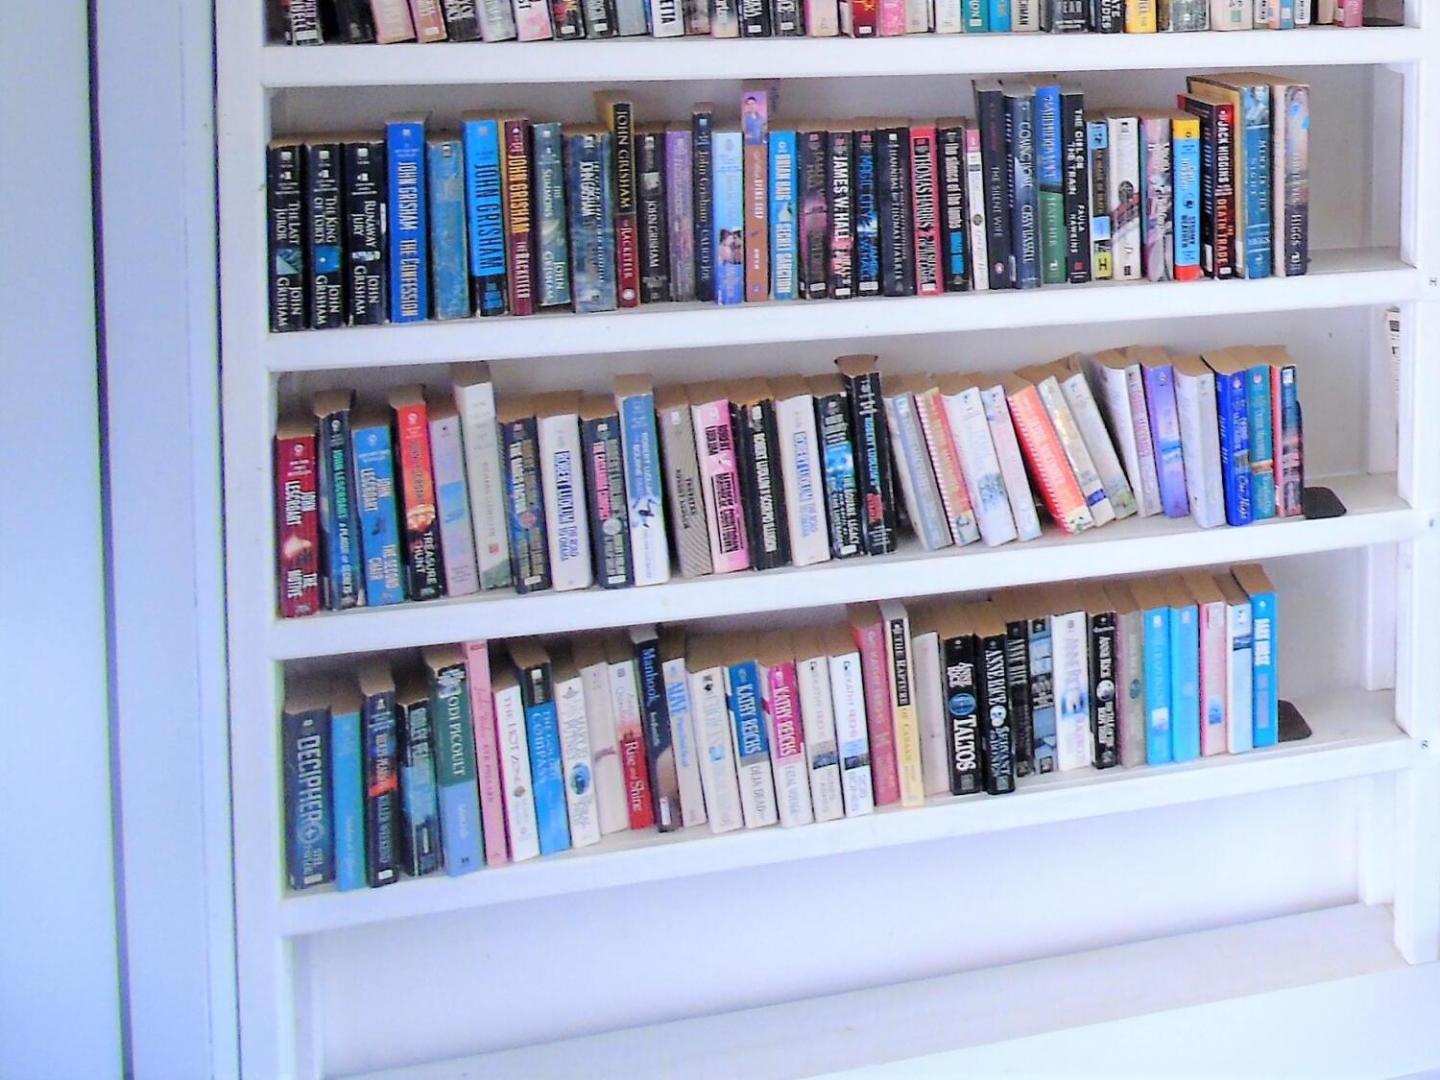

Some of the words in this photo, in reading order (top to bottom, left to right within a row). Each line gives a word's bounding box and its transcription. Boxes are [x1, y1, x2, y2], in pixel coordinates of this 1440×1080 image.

[616, 111, 629, 145] JOHN
[1074, 109, 1082, 127] THE
[1218, 120, 1231, 144] JACK
[397, 162, 417, 185] JOHN
[508, 155, 527, 181] JOHN
[699, 151, 711, 175] John
[832, 156, 848, 193] JAMES
[858, 155, 874, 191] MAGIC
[888, 149, 900, 191] HANNIBAL
[914, 153, 930, 197] THOMAS
[991, 166, 1000, 183] THE
[1218, 146, 1231, 183] HIGGINS
[474, 164, 497, 198] JOHN
[543, 169, 552, 218] SUMMONS
[618, 149, 632, 208] GRISHAM
[288, 201, 299, 220] THE
[326, 196, 337, 215] THE
[399, 187, 417, 230] GRISHAM
[510, 183, 530, 233] GRISHAM
[646, 200, 658, 225] JOHN
[834, 196, 848, 212] W.
[859, 193, 876, 218] CITY
[917, 199, 933, 228] HARRIS
[992, 185, 1002, 214] SILENT
[1217, 199, 1227, 230] DEATH
[275, 209, 288, 241] JUROR
[289, 222, 300, 244] LAST
[314, 214, 325, 244] TORTS
[326, 217, 338, 243] KING
[351, 214, 365, 236] JURY
[364, 200, 376, 248] RUNAWAY
[833, 213, 849, 241] HALL
[890, 201, 902, 240] THOMAS
[993, 216, 1003, 238] WIFE
[1291, 214, 1301, 246] HIGGS
[400, 239, 417, 257] THE
[476, 204, 504, 269] GRISHAM
[647, 226, 659, 267] GRISHAM
[1218, 233, 1229, 264] TRADE
[621, 228, 633, 279] RACKETEER
[892, 243, 903, 280] HARRIS
[368, 276, 379, 303] JOHN
[401, 258, 420, 317] CONFESSION
[515, 253, 530, 298] RACKETEER
[544, 251, 555, 300] GRISHAM
[554, 261, 565, 289] JOHN
[277, 278, 290, 326] GRISHAM
[289, 287, 301, 315] JOHN
[316, 275, 328, 324] GRISHAM
[327, 285, 340, 313] JOHN
[354, 266, 367, 315] GRISHAM
[717, 424, 731, 451] ROBERT
[864, 417, 875, 446] ROBERT
[332, 449, 342, 470] JOHN
[510, 442, 521, 458] THE
[593, 442, 605, 454] THE
[555, 451, 572, 487] ROBERT
[285, 480, 302, 526] LESCROART
[302, 491, 316, 512] JOHN
[334, 471, 347, 518] LESCROART
[378, 478, 391, 498] JOHN
[558, 489, 575, 524] LUDLUM
[848, 518, 859, 544] LEGACY
[384, 545, 396, 559] THE
[413, 546, 424, 575] HUNT
[424, 531, 436, 584] TREASURE
[287, 568, 302, 598] MOTIVE
[304, 573, 317, 588] THE
[369, 557, 381, 581] CHAIR
[385, 560, 400, 589] SECOND
[893, 636, 903, 658] THE
[1008, 639, 1026, 667] ANNE
[985, 650, 1003, 679] ANNE
[1010, 670, 1027, 686] RICE
[895, 659, 910, 705] RAPTURE
[987, 680, 1007, 706] RICE
[736, 684, 757, 716] KATHY
[773, 686, 792, 719] KATHY
[449, 723, 466, 776] PICOULT
[531, 713, 546, 783] COMPASS
[742, 720, 761, 754] REICHS
[777, 720, 796, 756] REICHS
[953, 714, 977, 771] TALTOS
[624, 741, 638, 766] Rise
[297, 736, 324, 823] DECIPHER
[630, 780, 644, 812] Shine
